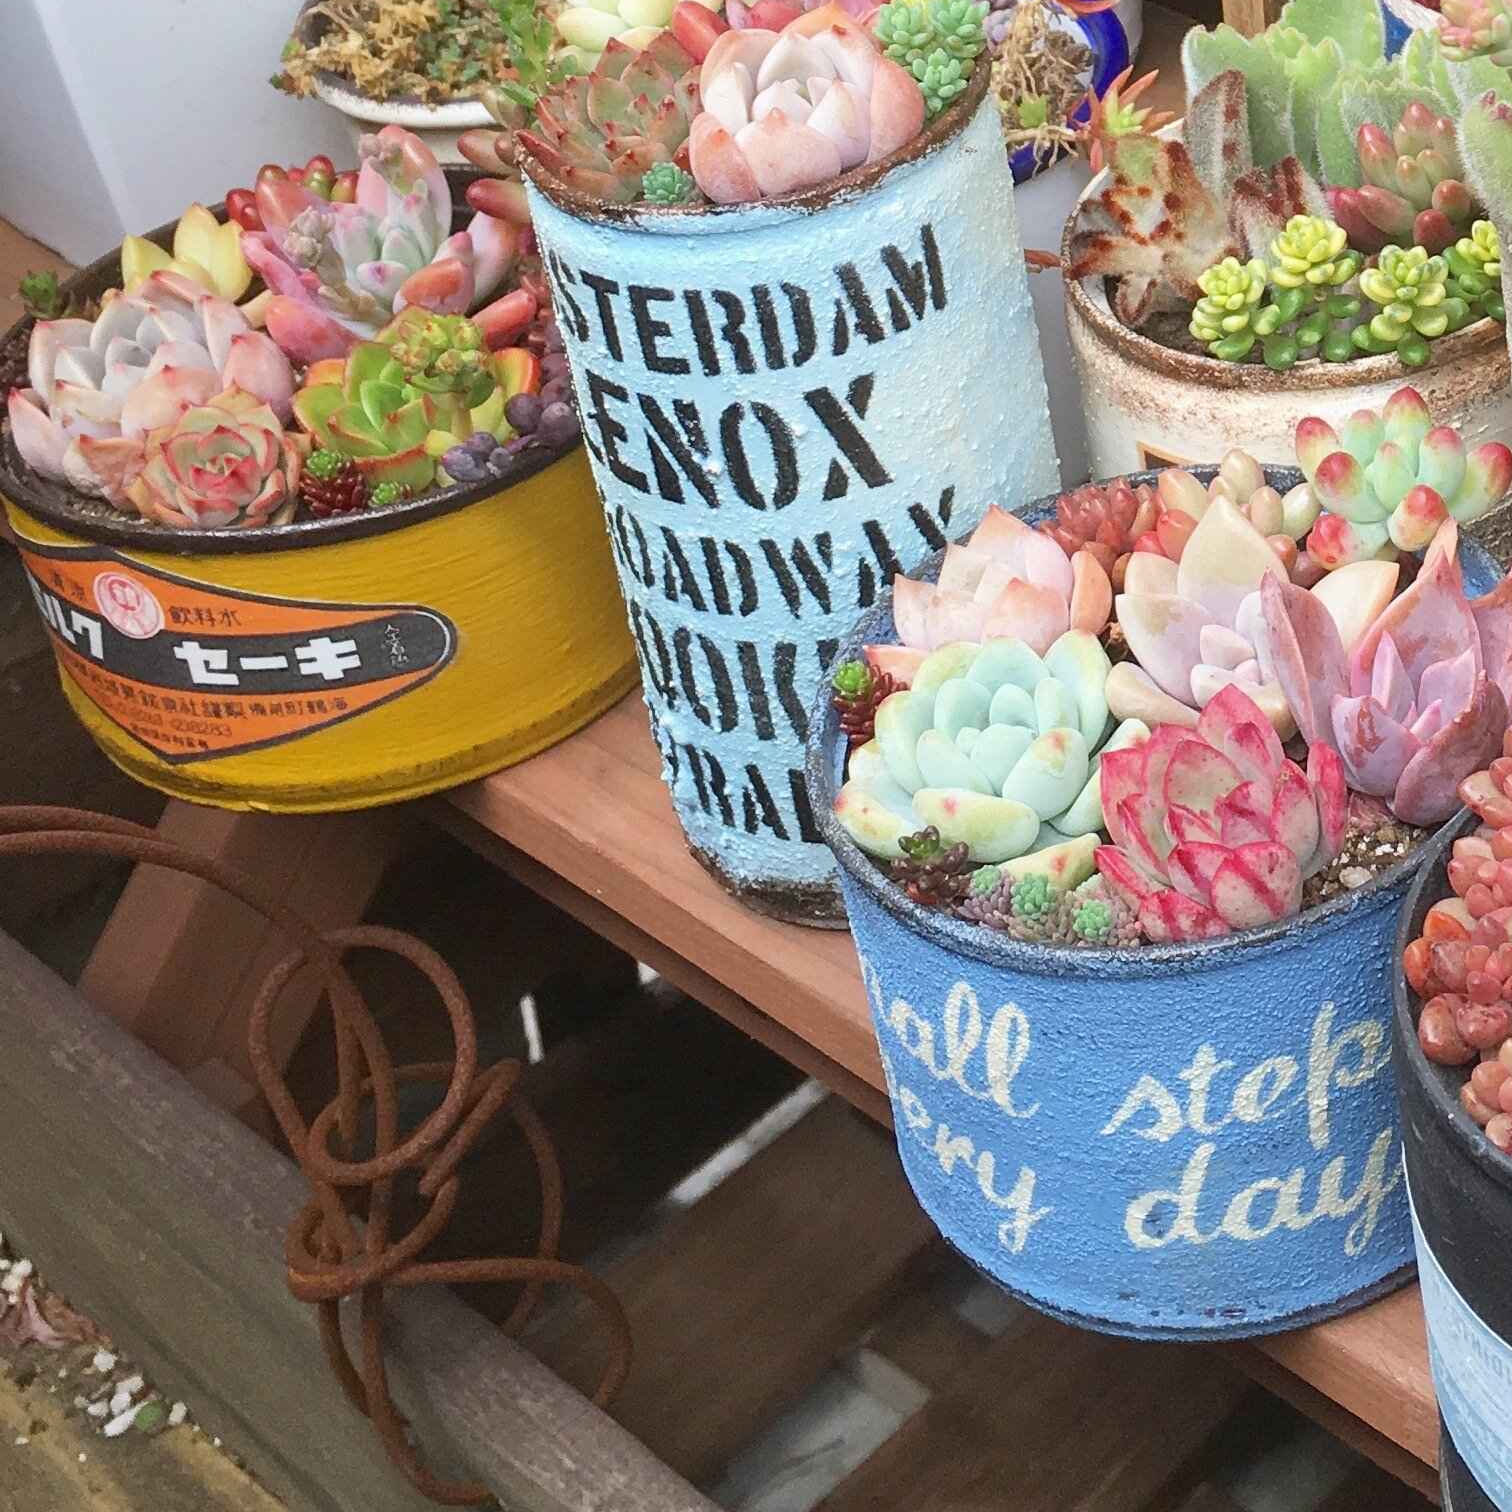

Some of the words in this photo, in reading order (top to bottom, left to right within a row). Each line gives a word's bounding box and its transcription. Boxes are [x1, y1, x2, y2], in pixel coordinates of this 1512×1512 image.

[585, 368, 894, 511] ENOX
[172, 636, 362, 686] セーキ
[866, 960, 1041, 1119] all
[1100, 1000, 1393, 1151] step
[884, 1054, 1052, 1255] ery
[1122, 1128, 1403, 1257] day
